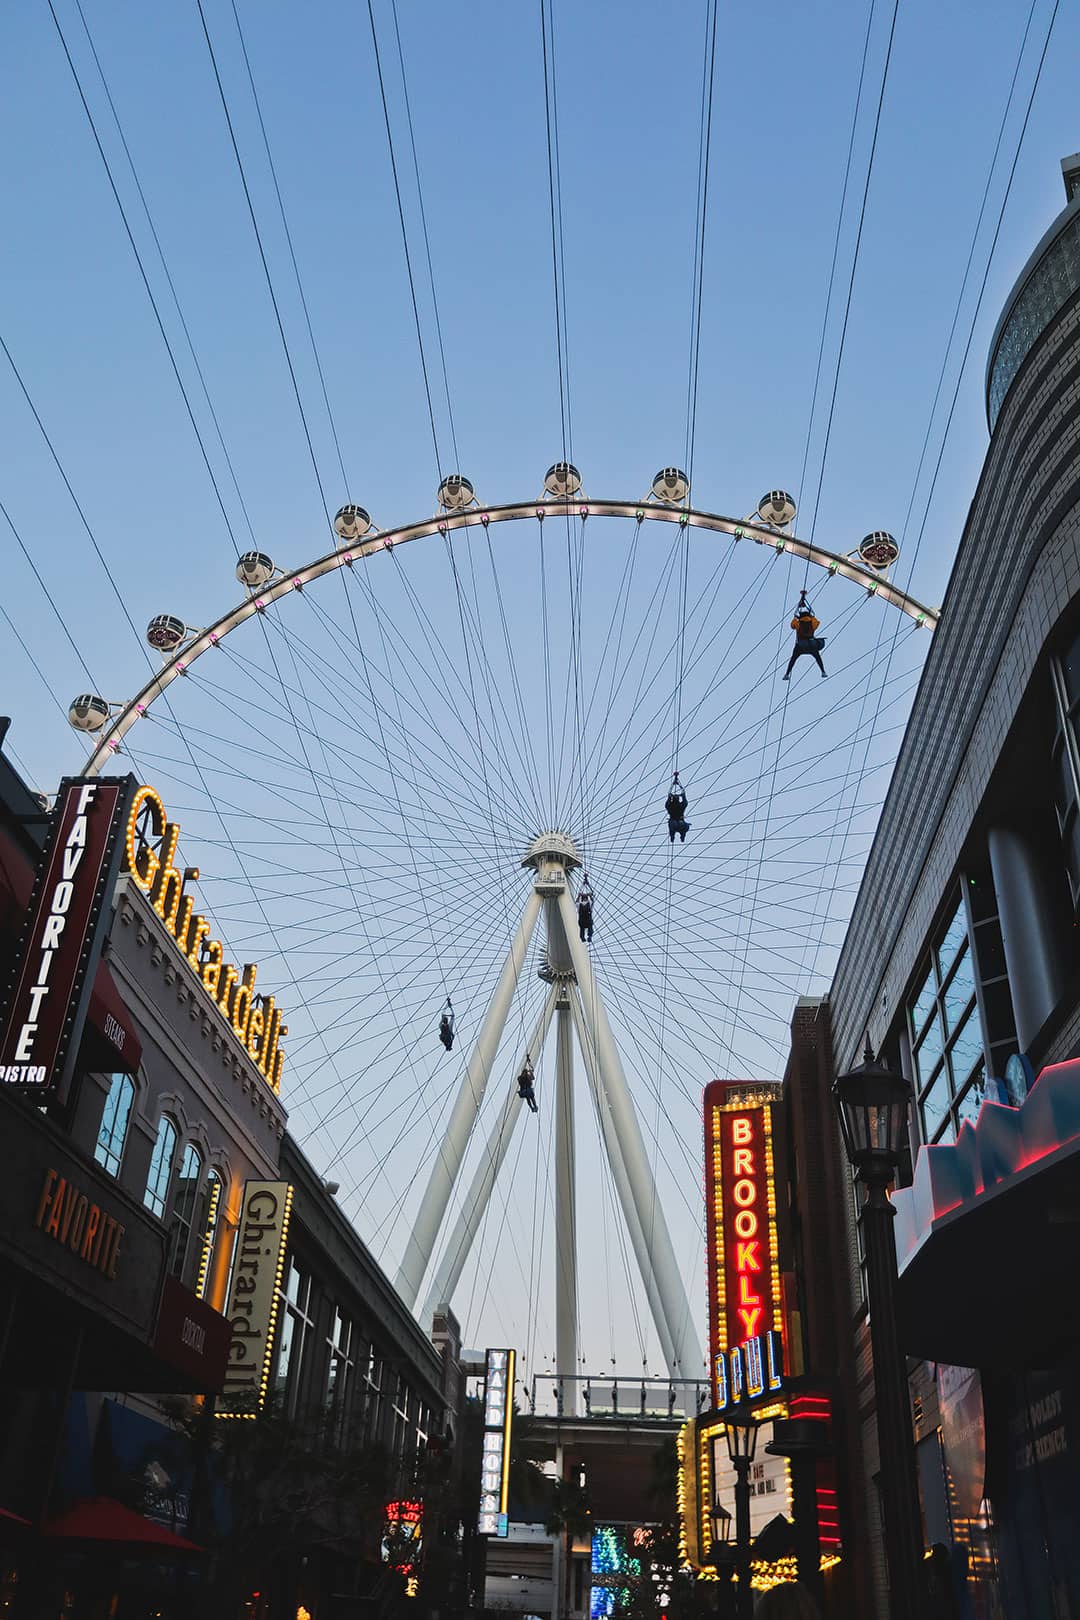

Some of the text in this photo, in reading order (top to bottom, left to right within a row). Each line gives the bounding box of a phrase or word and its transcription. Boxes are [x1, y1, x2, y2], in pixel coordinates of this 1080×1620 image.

[14, 784, 97, 1061] FAVORITE
[127, 785, 288, 1096] Ghirardelli
[103, 1013, 126, 1051] STEAKS
[37, 1167, 126, 1281] FAVORITE
[222, 1189, 278, 1388] Ghirardell
[731, 1118, 761, 1338] BROOKLY
[481, 1352, 506, 1533] YARD HOUSE
[714, 1331, 782, 1410] BOWL
